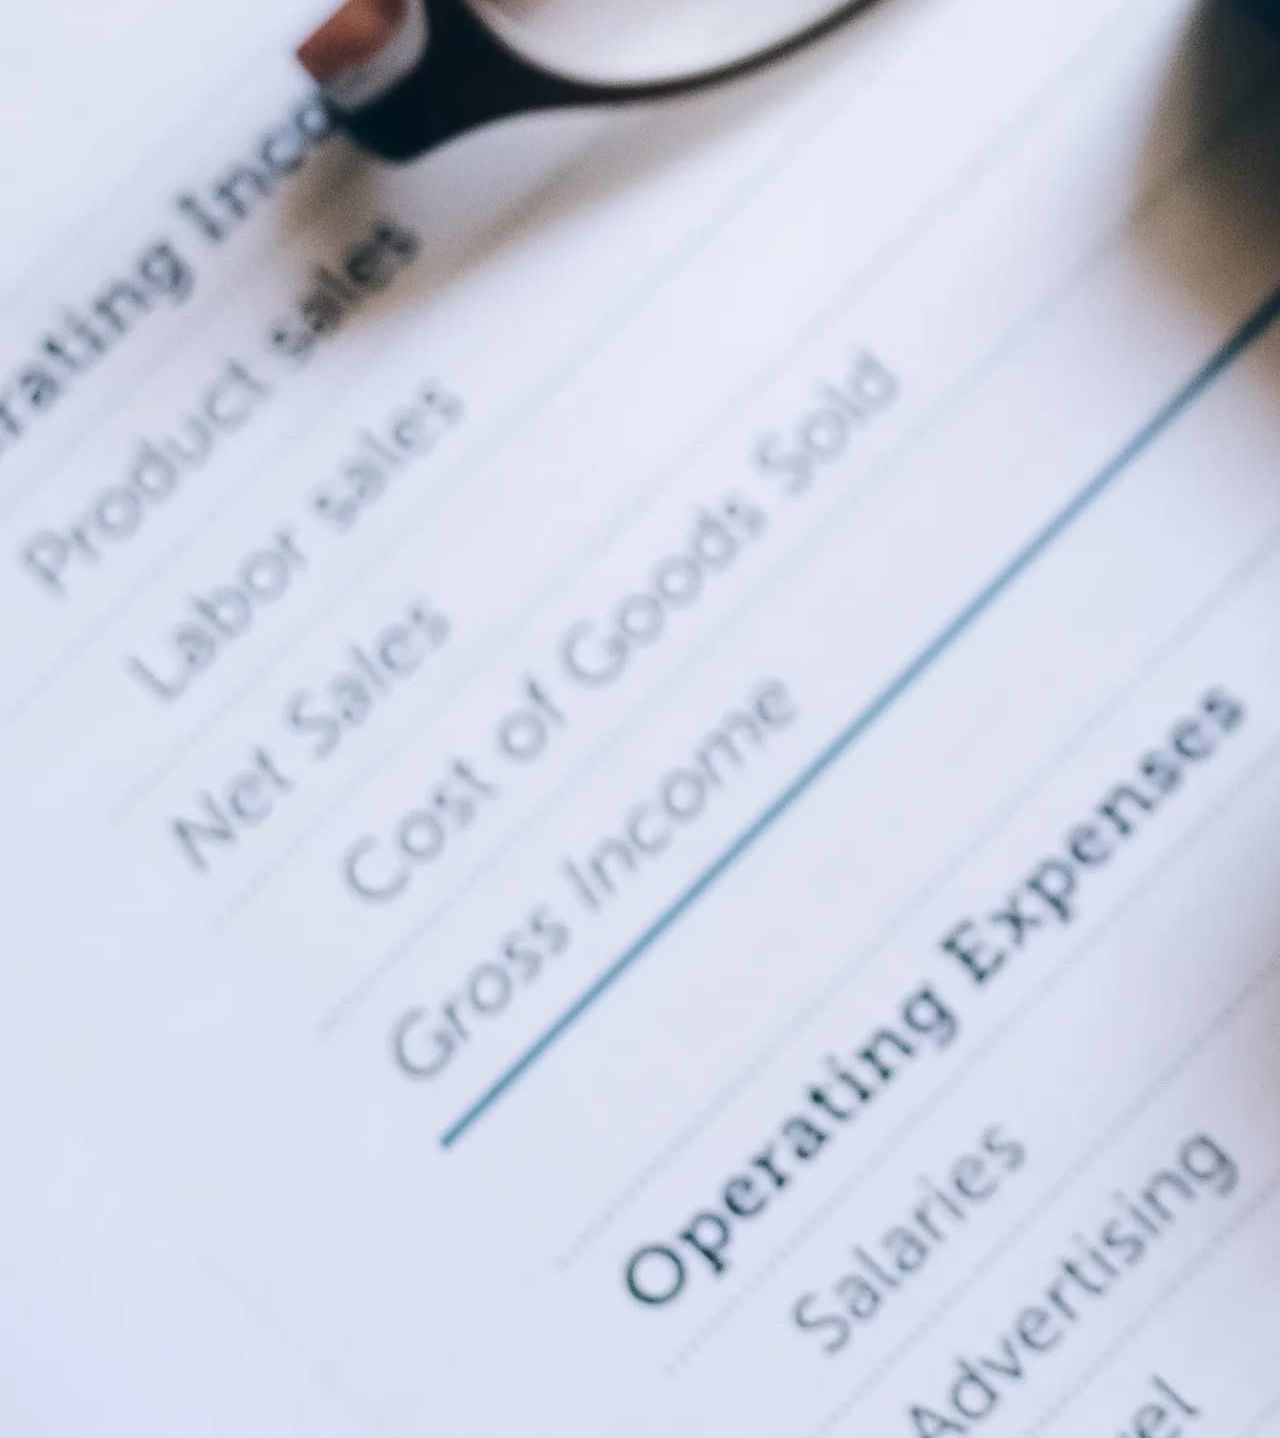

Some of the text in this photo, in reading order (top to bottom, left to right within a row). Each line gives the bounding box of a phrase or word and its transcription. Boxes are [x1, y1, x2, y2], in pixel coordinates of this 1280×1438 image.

[0, 90, 335, 446] rating Inco
[20, 220, 422, 595] Product sales
[126, 378, 466, 701] Labor sales
[339, 348, 902, 908] Cost of Goods Sold
[167, 593, 454, 878] Net Sales
[388, 670, 798, 1081] Gross Income
[621, 680, 1247, 1313] Operating Expenses
[789, 1122, 1027, 1356] Salaries
